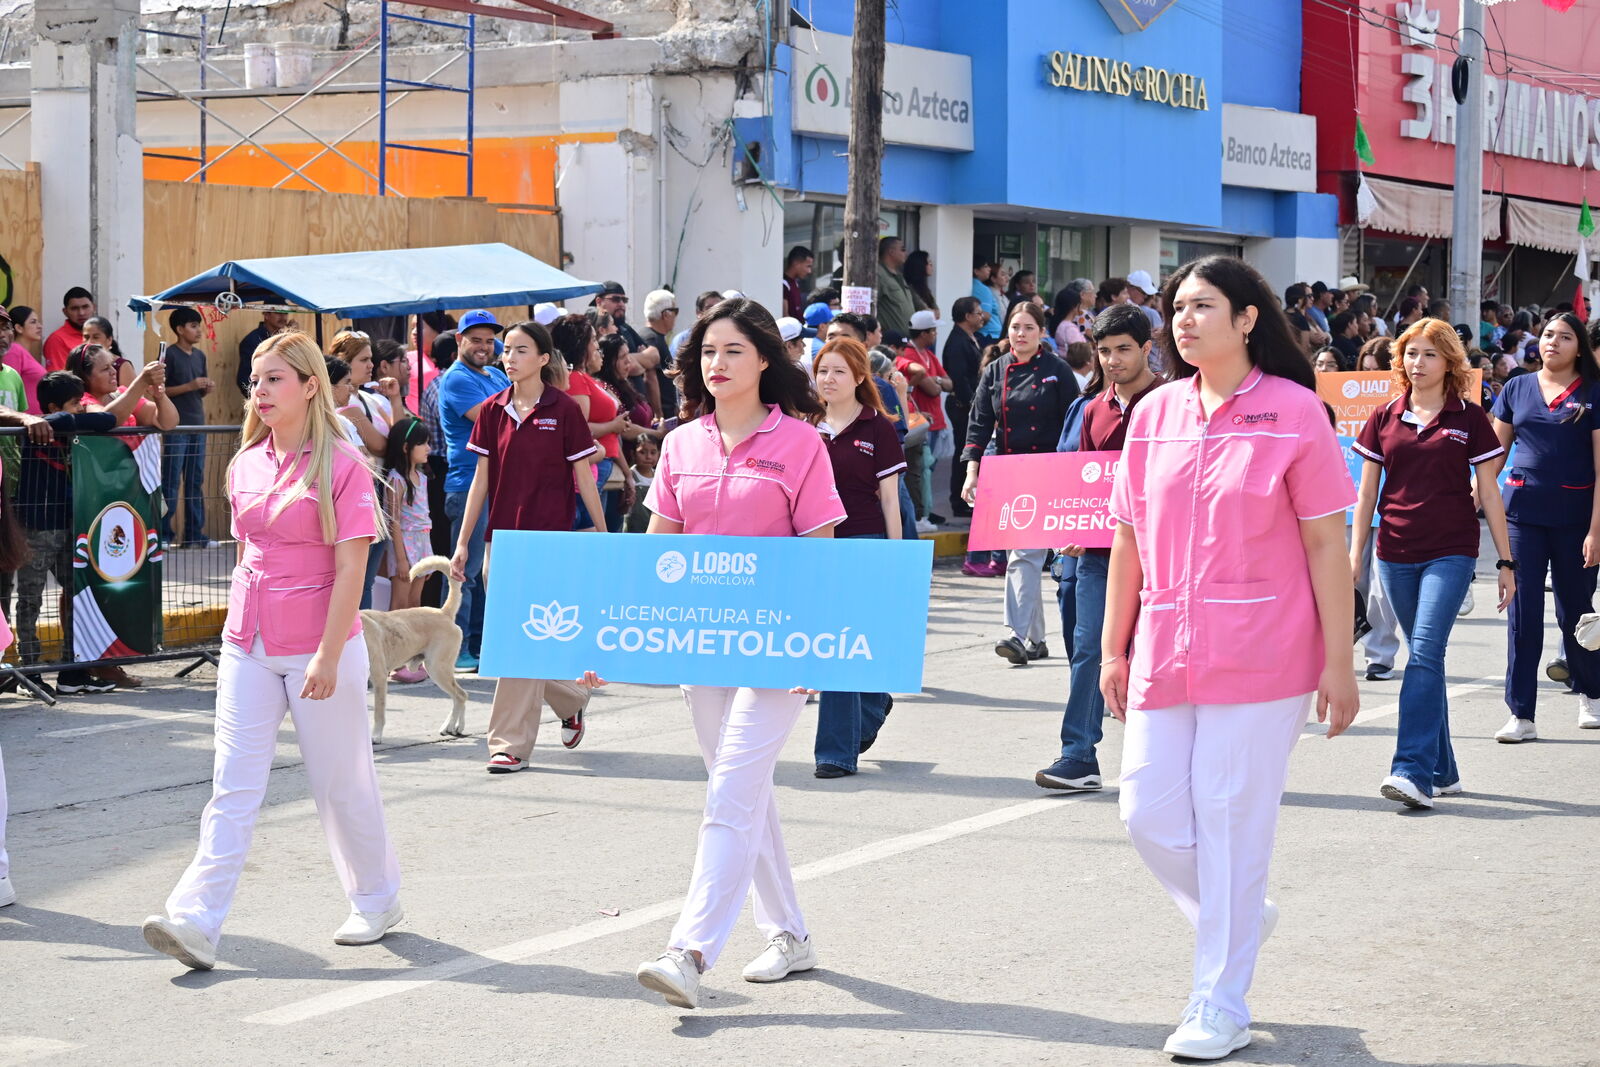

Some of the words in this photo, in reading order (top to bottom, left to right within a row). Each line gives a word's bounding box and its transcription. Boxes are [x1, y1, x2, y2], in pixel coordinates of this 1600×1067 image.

[1049, 50, 1132, 97] SALINAS
[1133, 70, 1144, 92] &
[1143, 65, 1209, 111] ROCHA
[907, 86, 969, 124] Azteca
[1400, 53, 1434, 140] 3
[1432, 63, 1600, 171] HRMANOS
[1226, 136, 1267, 167] Banco
[1269, 142, 1312, 171] Azteca
[1361, 379, 1389, 393] UAD
[690, 575, 756, 587] MONCLOVA
[692, 551, 758, 576] LOBOS
[609, 604, 750, 624] LICENCIATURA
[755, 609, 783, 625] EN
[596, 625, 874, 661] COSMETOLOGÍA
